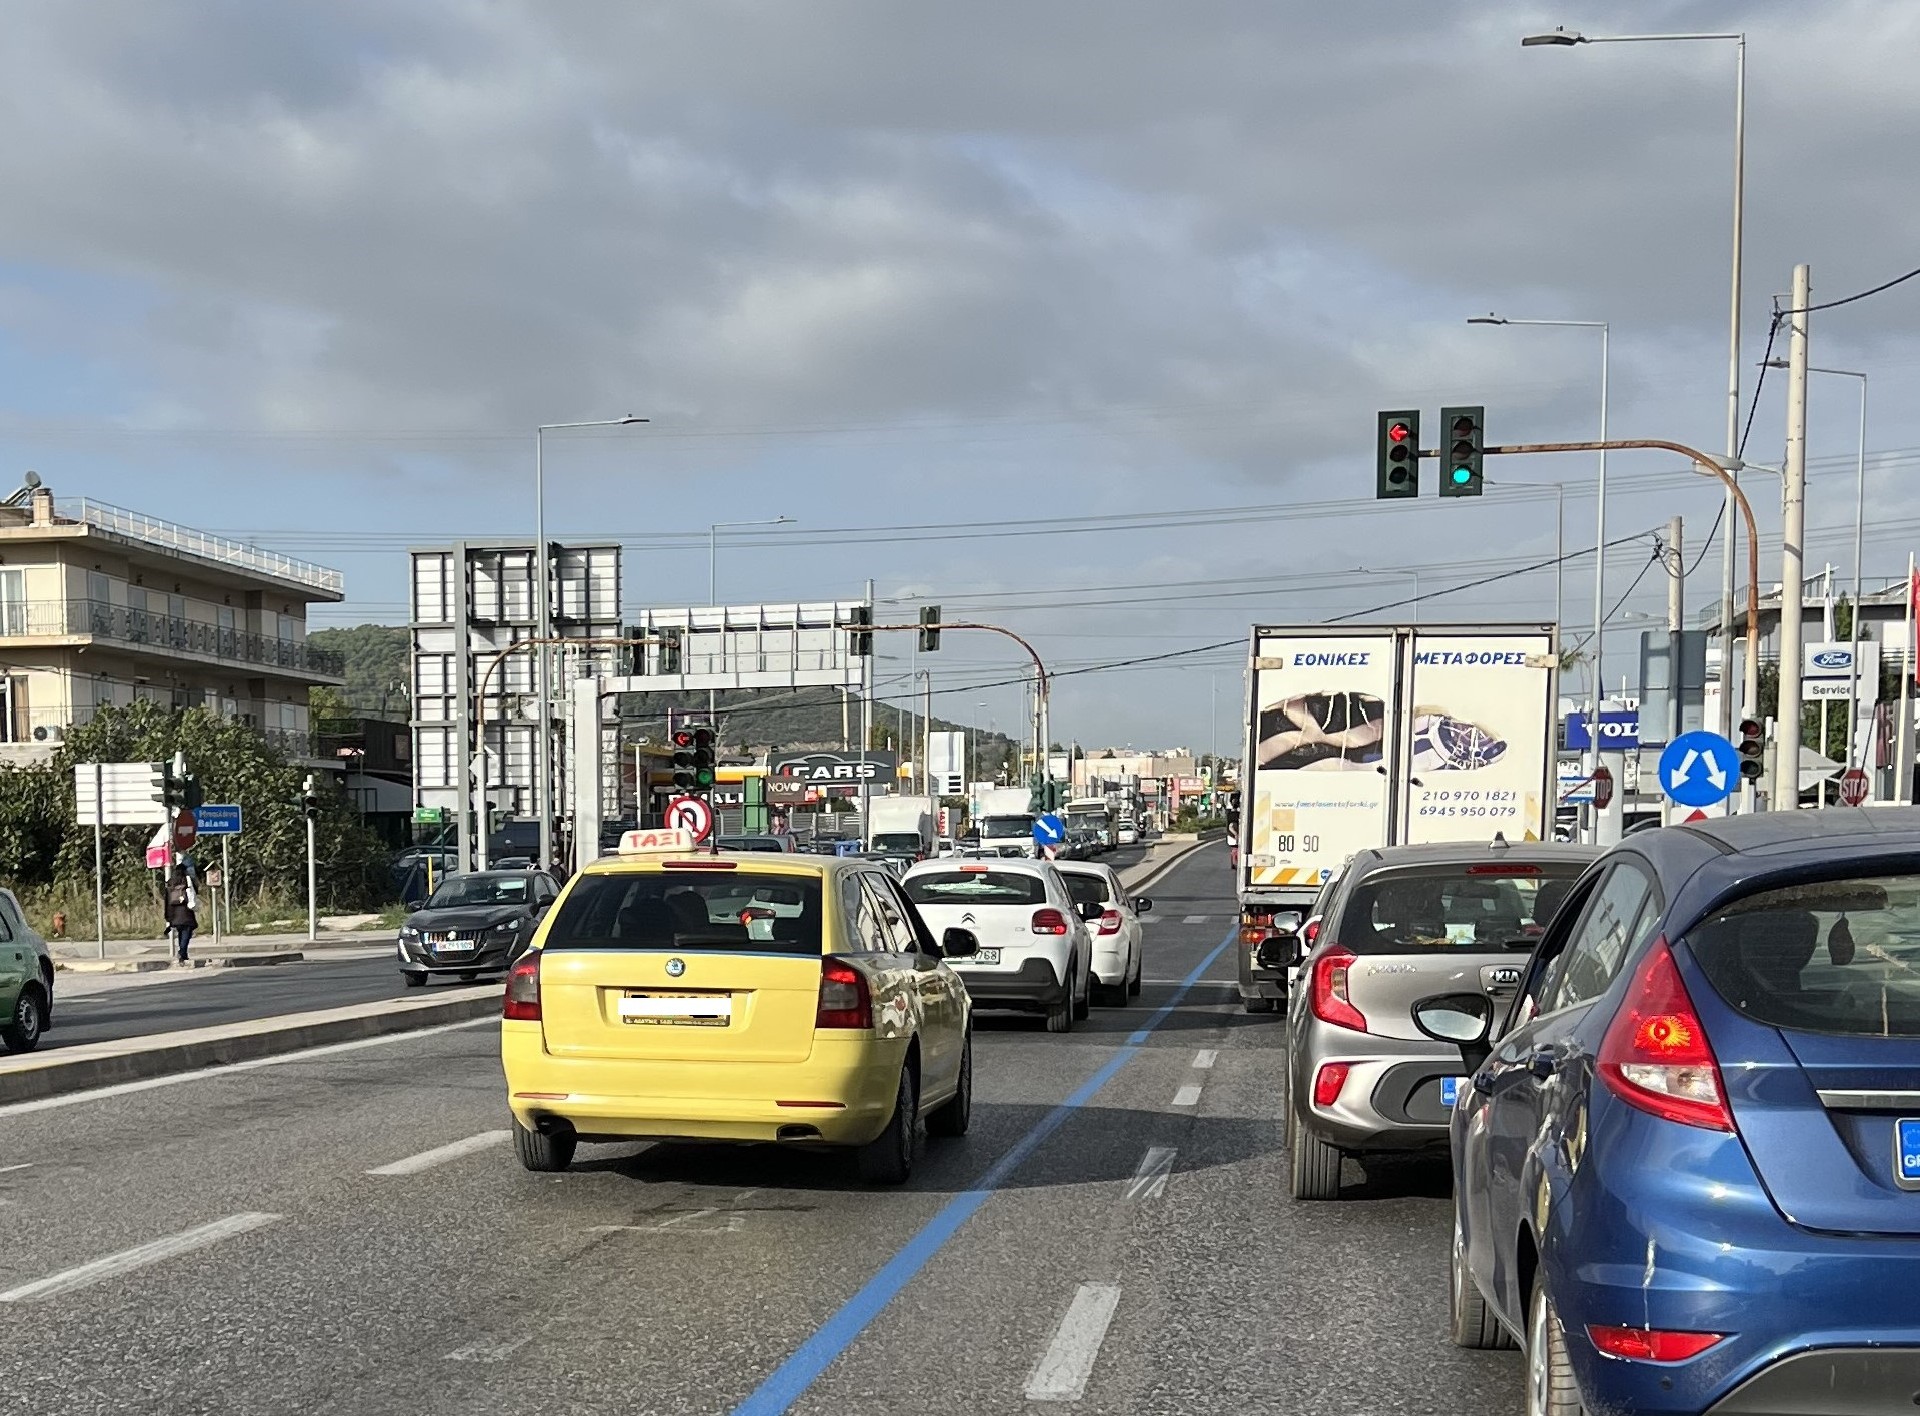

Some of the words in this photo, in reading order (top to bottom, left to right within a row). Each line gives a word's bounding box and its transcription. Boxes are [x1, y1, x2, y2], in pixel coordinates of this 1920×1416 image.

[1582, 723, 1638, 736] VOL
[1423, 791, 1449, 800] 210
[1454, 791, 1479, 800] 970
[1486, 791, 1516, 800] 1821
[1596, 780, 1612, 799] TOP
[1420, 806, 1455, 816] 6945
[1461, 807, 1485, 816] 950
[1490, 807, 1516, 816] 079
[628, 832, 681, 848] ΤΑΞΙ
[1279, 835, 1294, 852] 80
[1303, 835, 1319, 852] 90
[1496, 971, 1519, 981] KIA
